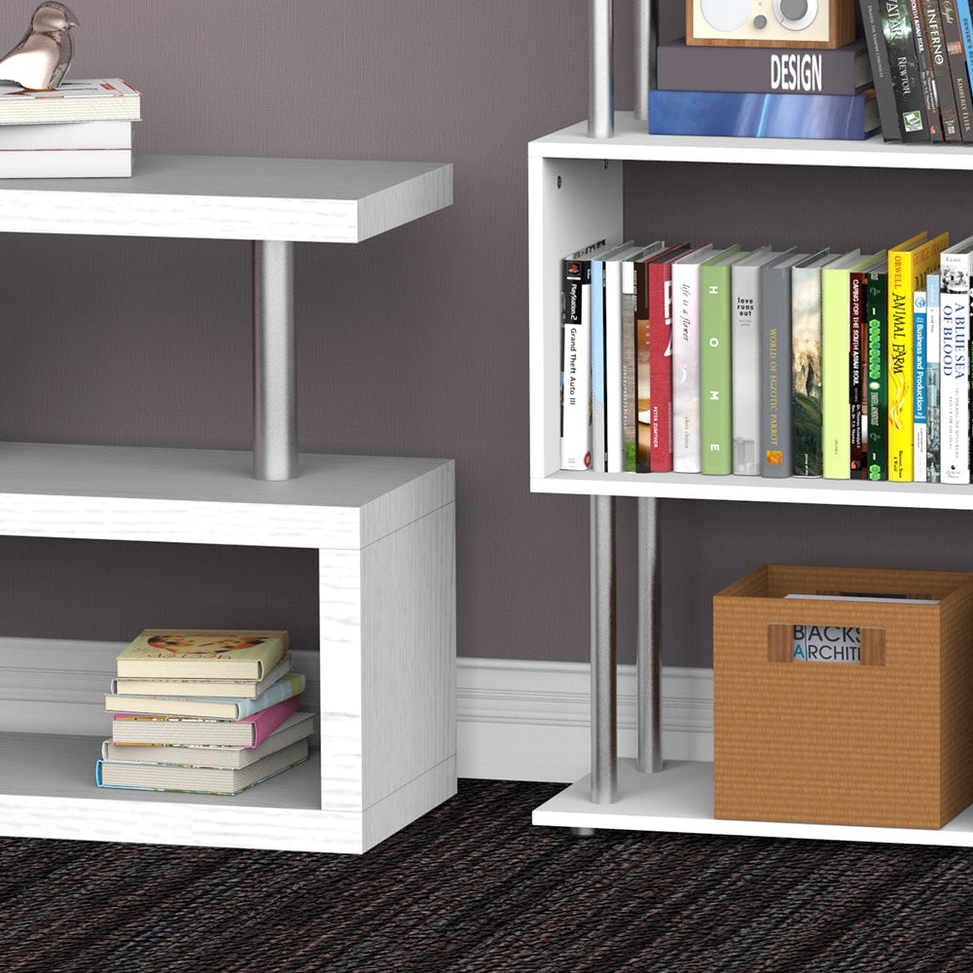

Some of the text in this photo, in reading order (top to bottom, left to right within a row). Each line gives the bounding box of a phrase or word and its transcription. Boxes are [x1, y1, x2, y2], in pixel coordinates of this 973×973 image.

[909, 0, 919, 19] SOUTH
[770, 54, 823, 92] DESIGN
[896, 56, 912, 96] NEWTON
[893, 255, 902, 289] ORWELL
[680, 315, 691, 342] flower
[769, 328, 777, 358] WORLD
[892, 292, 907, 374] ANIMAL FARM
[943, 305, 953, 376] OF BLOOD
[955, 303, 966, 379] A BLUE SEA
[569, 328, 577, 405] Grand Theft Auto III
[769, 361, 777, 371] OF
[916, 324, 924, 410] Business and Production
[769, 414, 777, 446] PARROT
